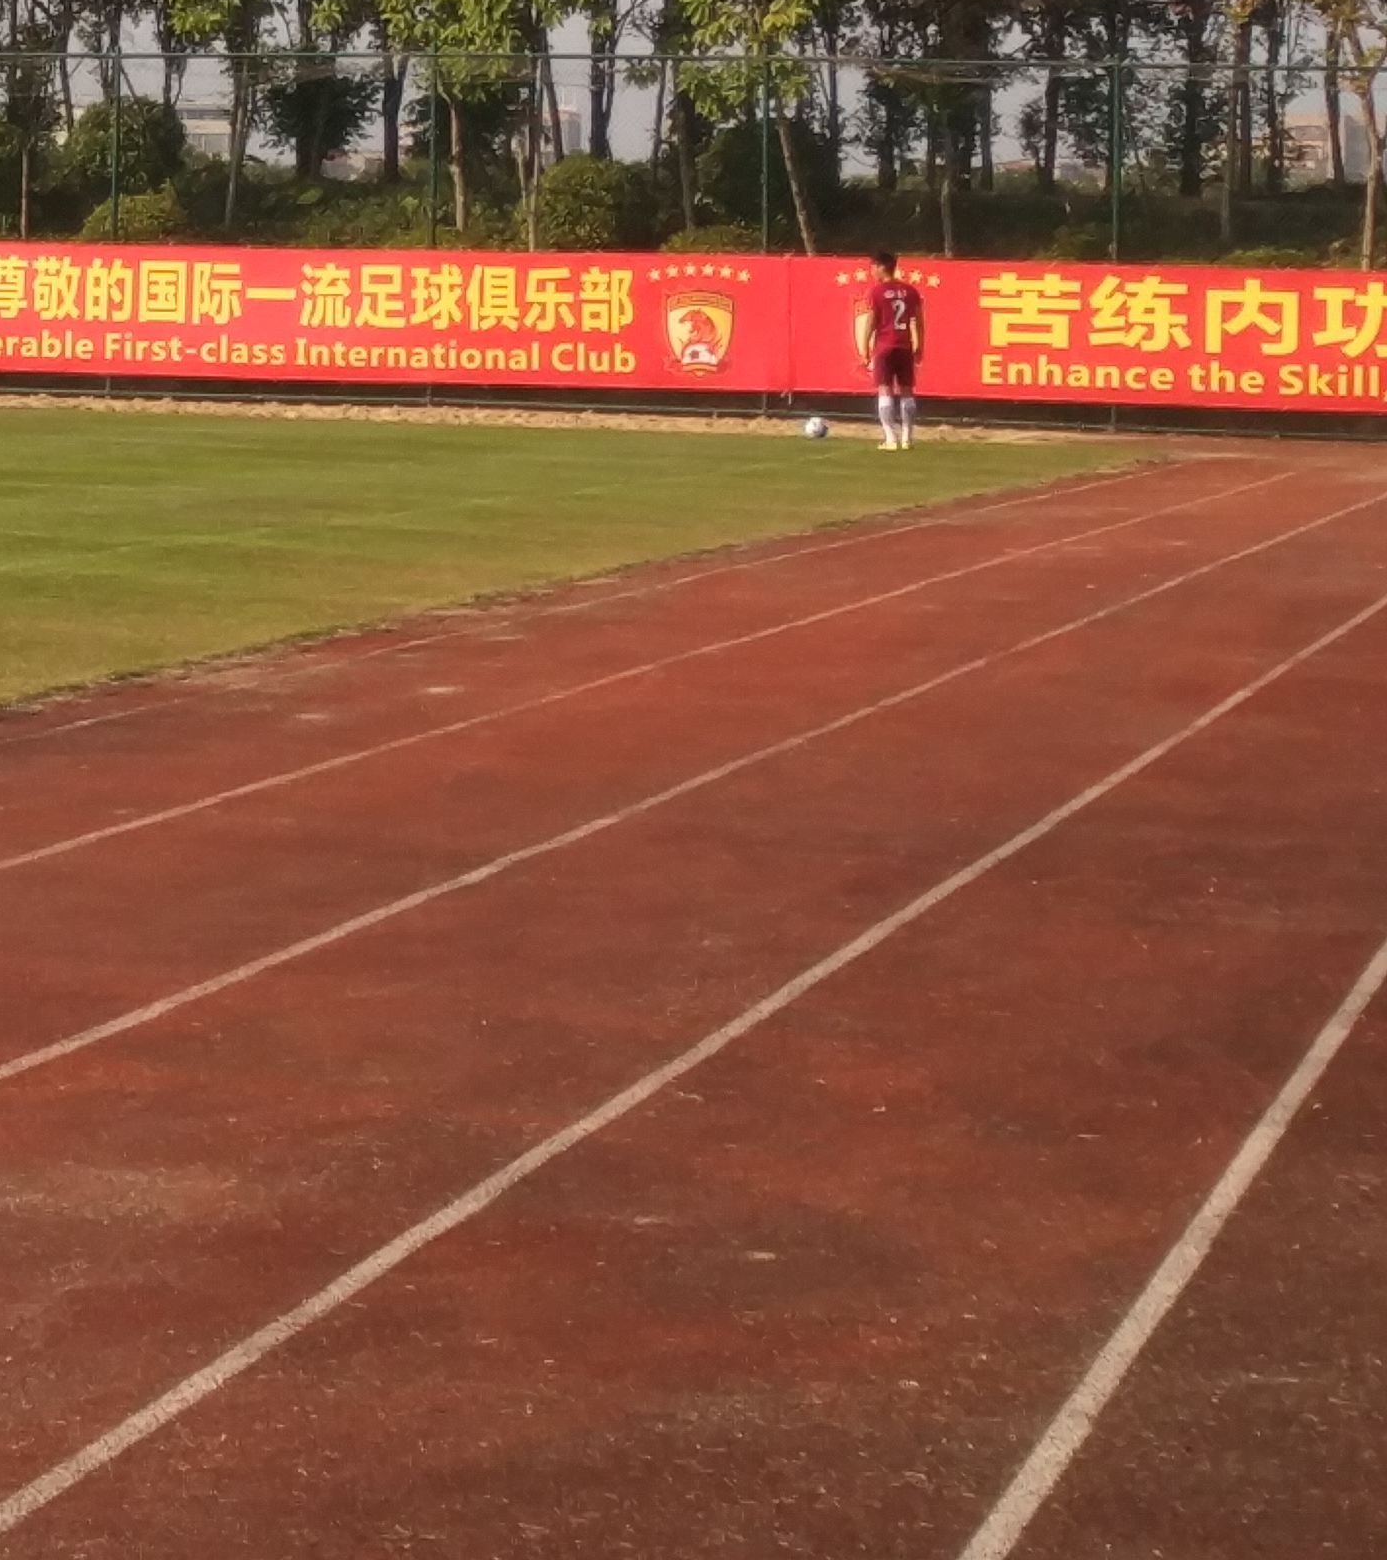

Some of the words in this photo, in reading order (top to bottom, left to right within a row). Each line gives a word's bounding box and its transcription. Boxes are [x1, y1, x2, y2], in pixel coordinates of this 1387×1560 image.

[891, 299, 908, 331] 2
[976, 270, 1387, 360] 苦练内功
[103, 330, 287, 366] First-class
[293, 336, 541, 372] International
[550, 340, 638, 375] Club
[979, 352, 1177, 392] Enhance
[1187, 358, 1267, 396] the
